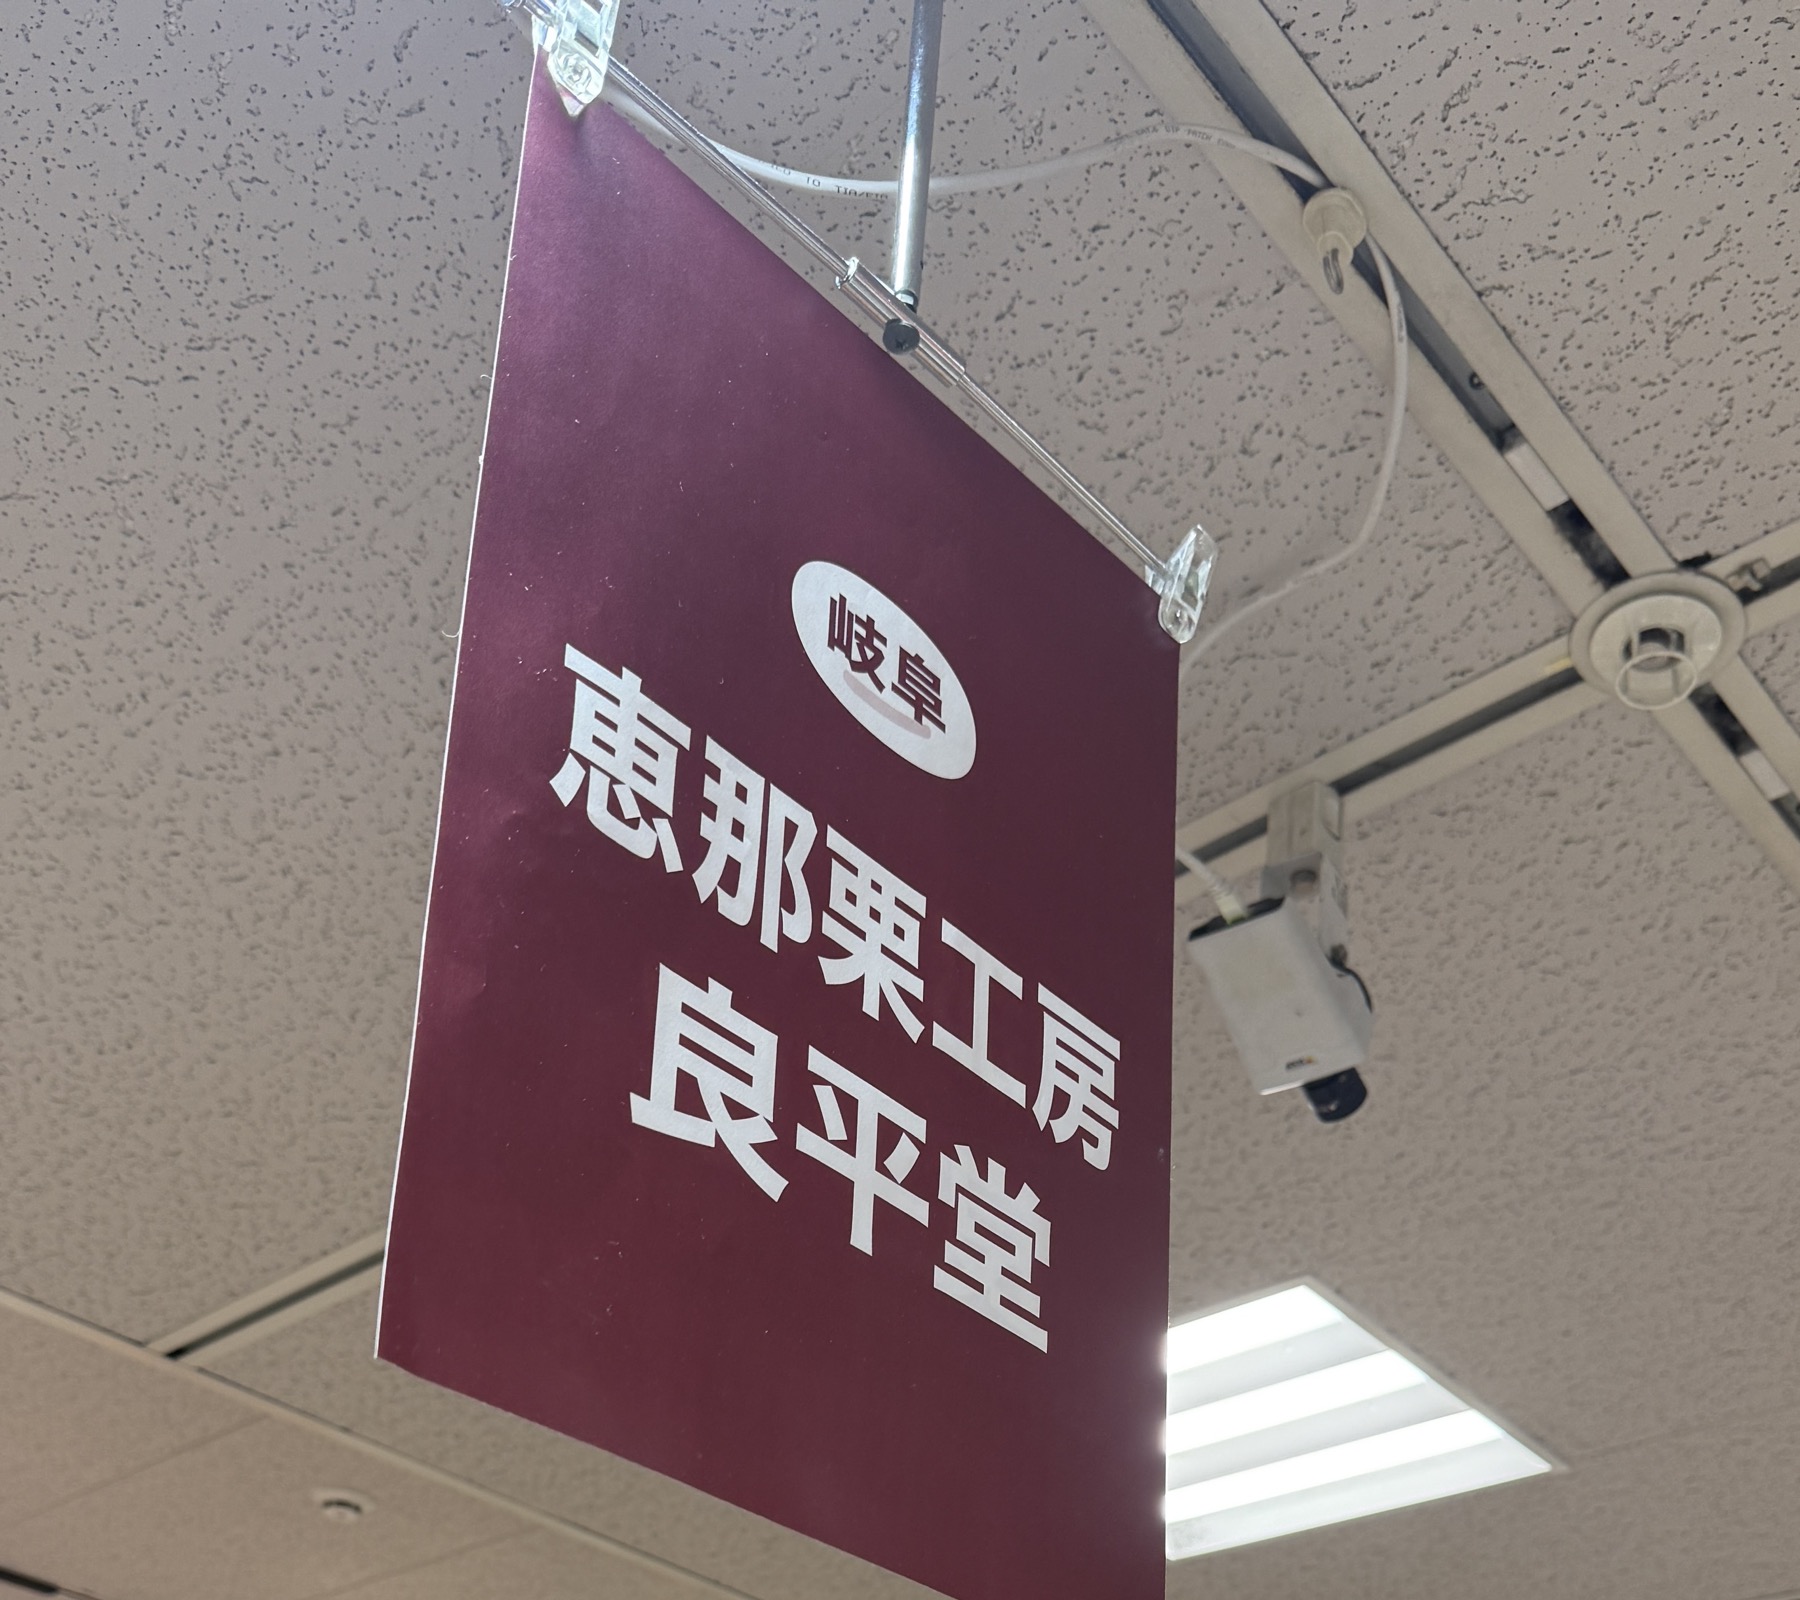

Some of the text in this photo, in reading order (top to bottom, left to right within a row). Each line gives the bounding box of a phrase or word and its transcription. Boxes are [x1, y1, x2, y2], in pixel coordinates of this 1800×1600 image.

[827, 592, 946, 734] 岐阜
[549, 643, 1121, 1171] 恵那栗工房
[630, 963, 1052, 1354] 良平堂
